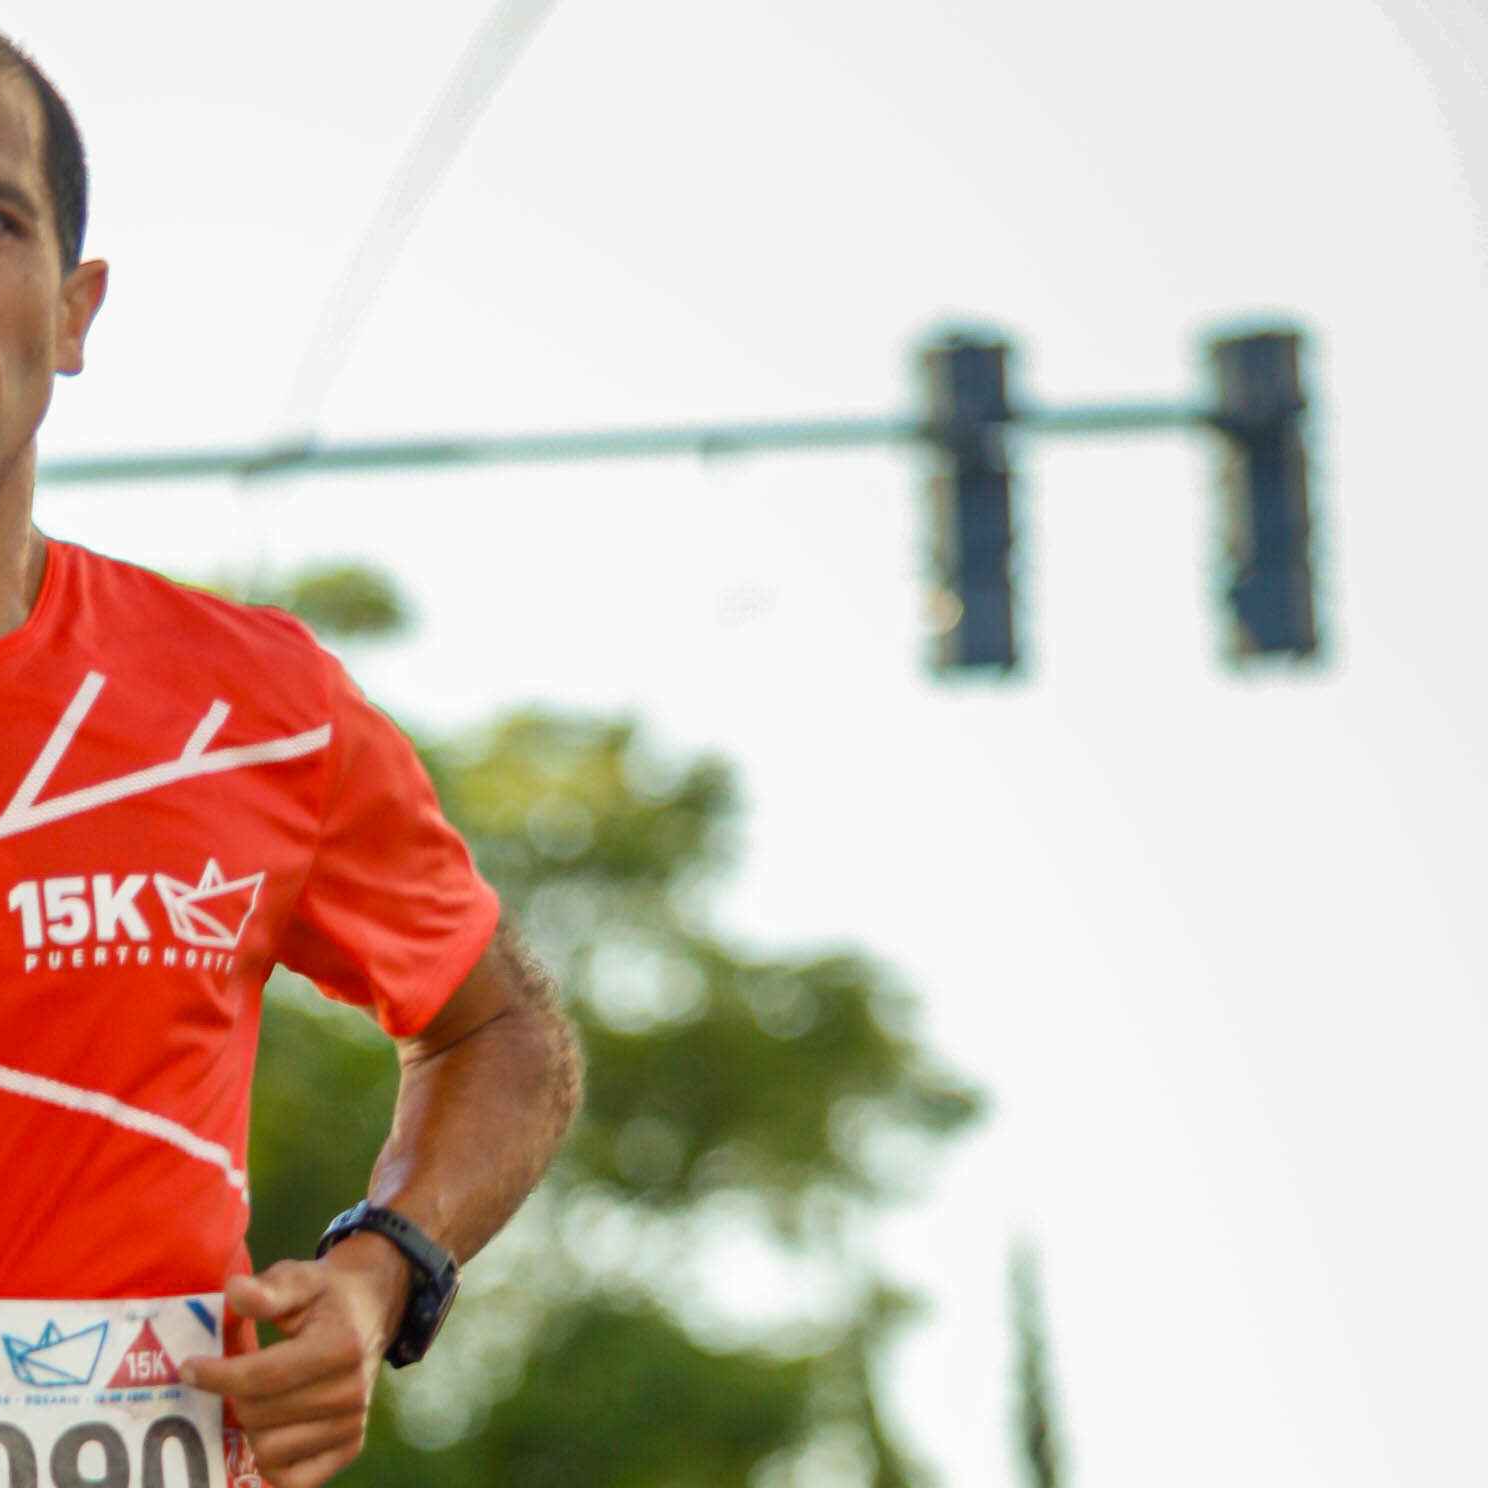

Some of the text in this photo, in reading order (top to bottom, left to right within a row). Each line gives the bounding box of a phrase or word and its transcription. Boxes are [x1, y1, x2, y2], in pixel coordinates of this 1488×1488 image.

[8, 873, 152, 949] 15K
[25, 945, 152, 973] PUERTO
[127, 1351, 168, 1380] 15K
